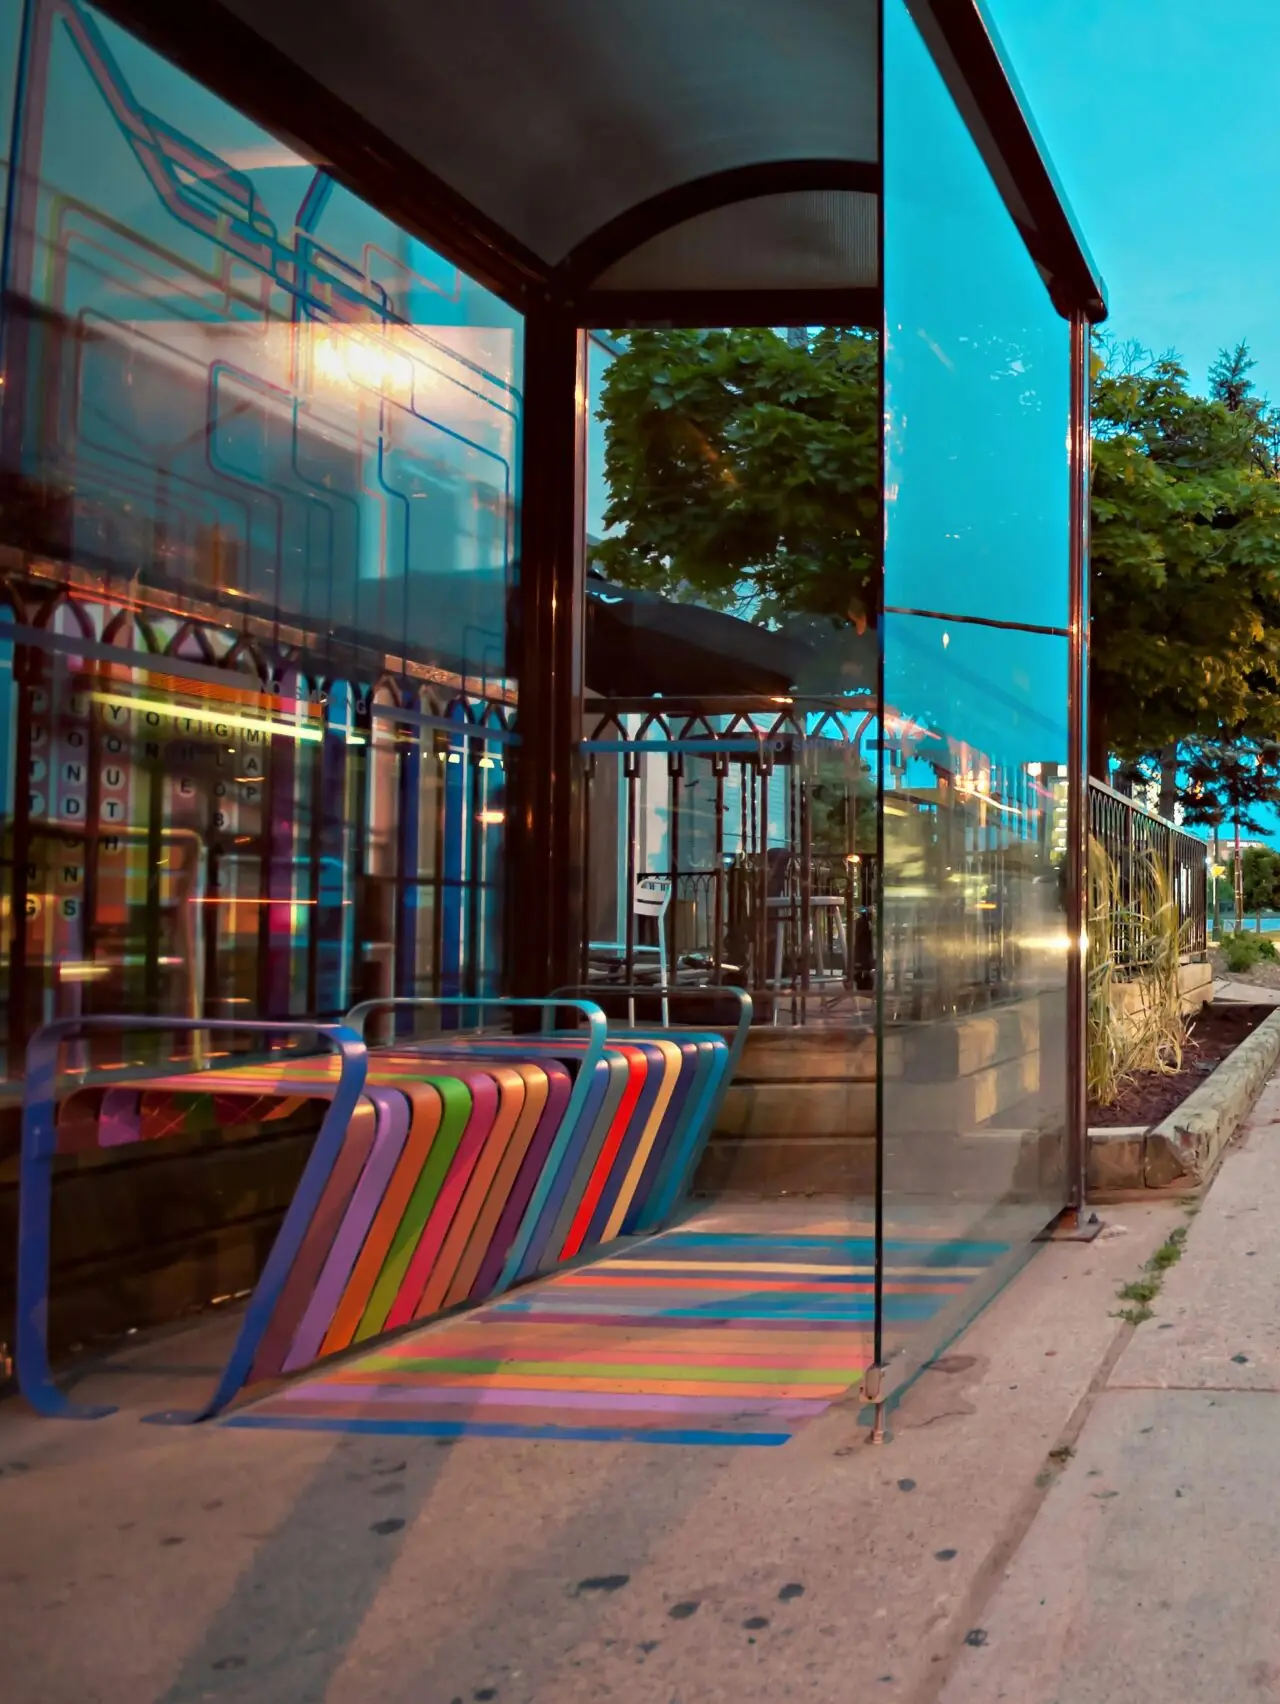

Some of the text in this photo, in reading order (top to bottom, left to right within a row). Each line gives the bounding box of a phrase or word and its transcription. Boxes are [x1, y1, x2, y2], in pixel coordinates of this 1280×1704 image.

[146, 711, 160, 760] ON
[243, 729, 258, 799] MAP
[103, 705, 123, 851] YOUTH
